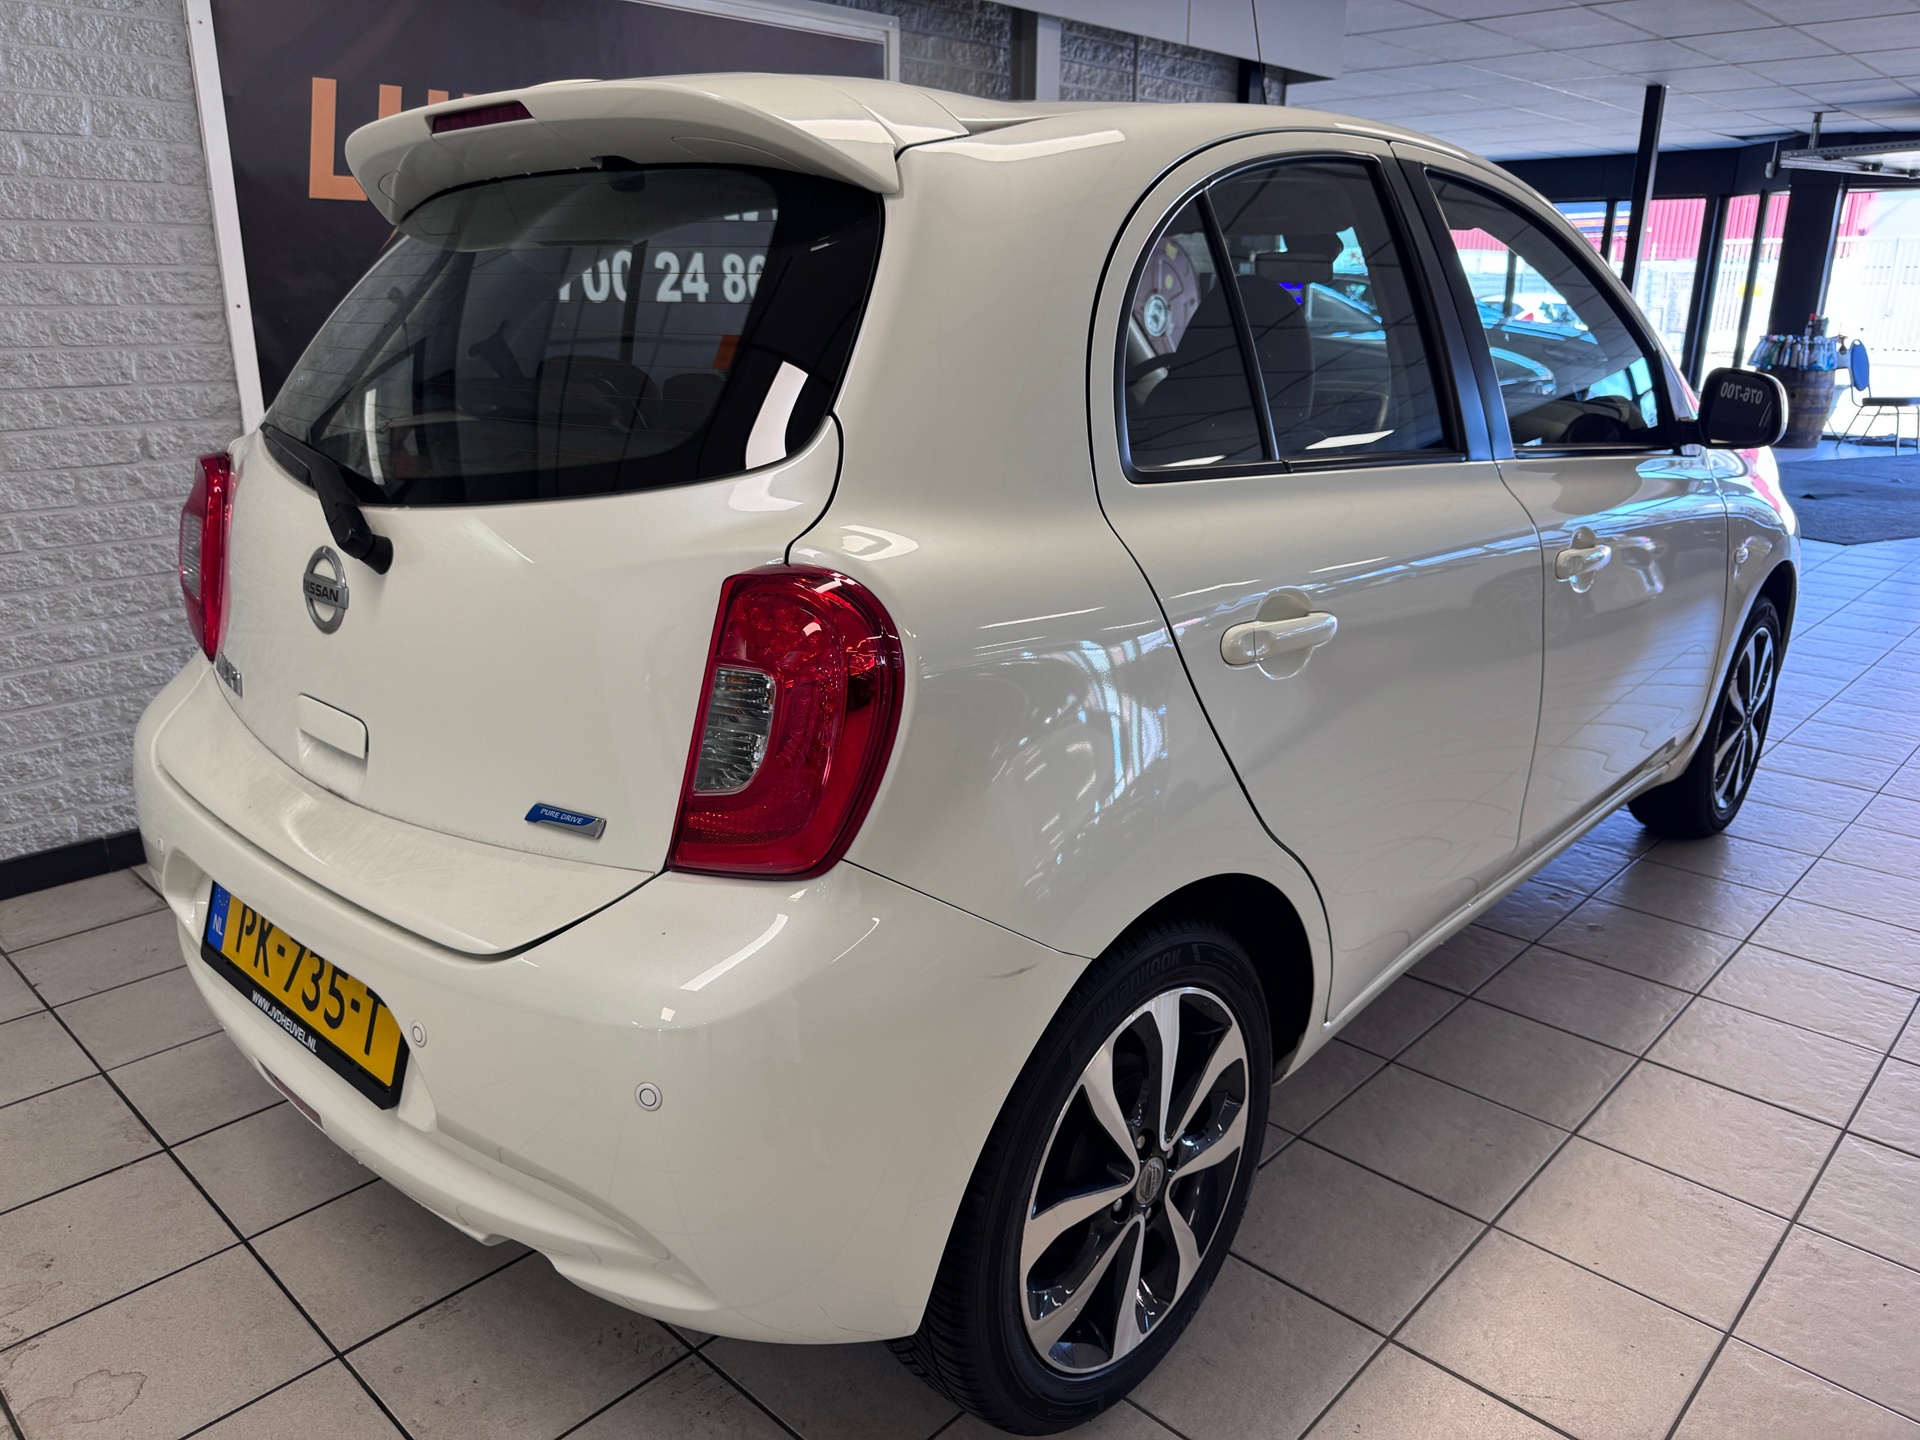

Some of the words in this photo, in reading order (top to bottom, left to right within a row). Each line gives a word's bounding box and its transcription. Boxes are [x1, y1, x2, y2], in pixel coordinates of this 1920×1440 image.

[654, 250, 709, 303] 24
[540, 808, 560, 819] PURE
[560, 813, 584, 825] DRIVE
[212, 913, 223, 936] NL
[236, 903, 387, 1056] PK-735-T
[252, 990, 317, 1053] WWW.JVDHEUVEL.NL
